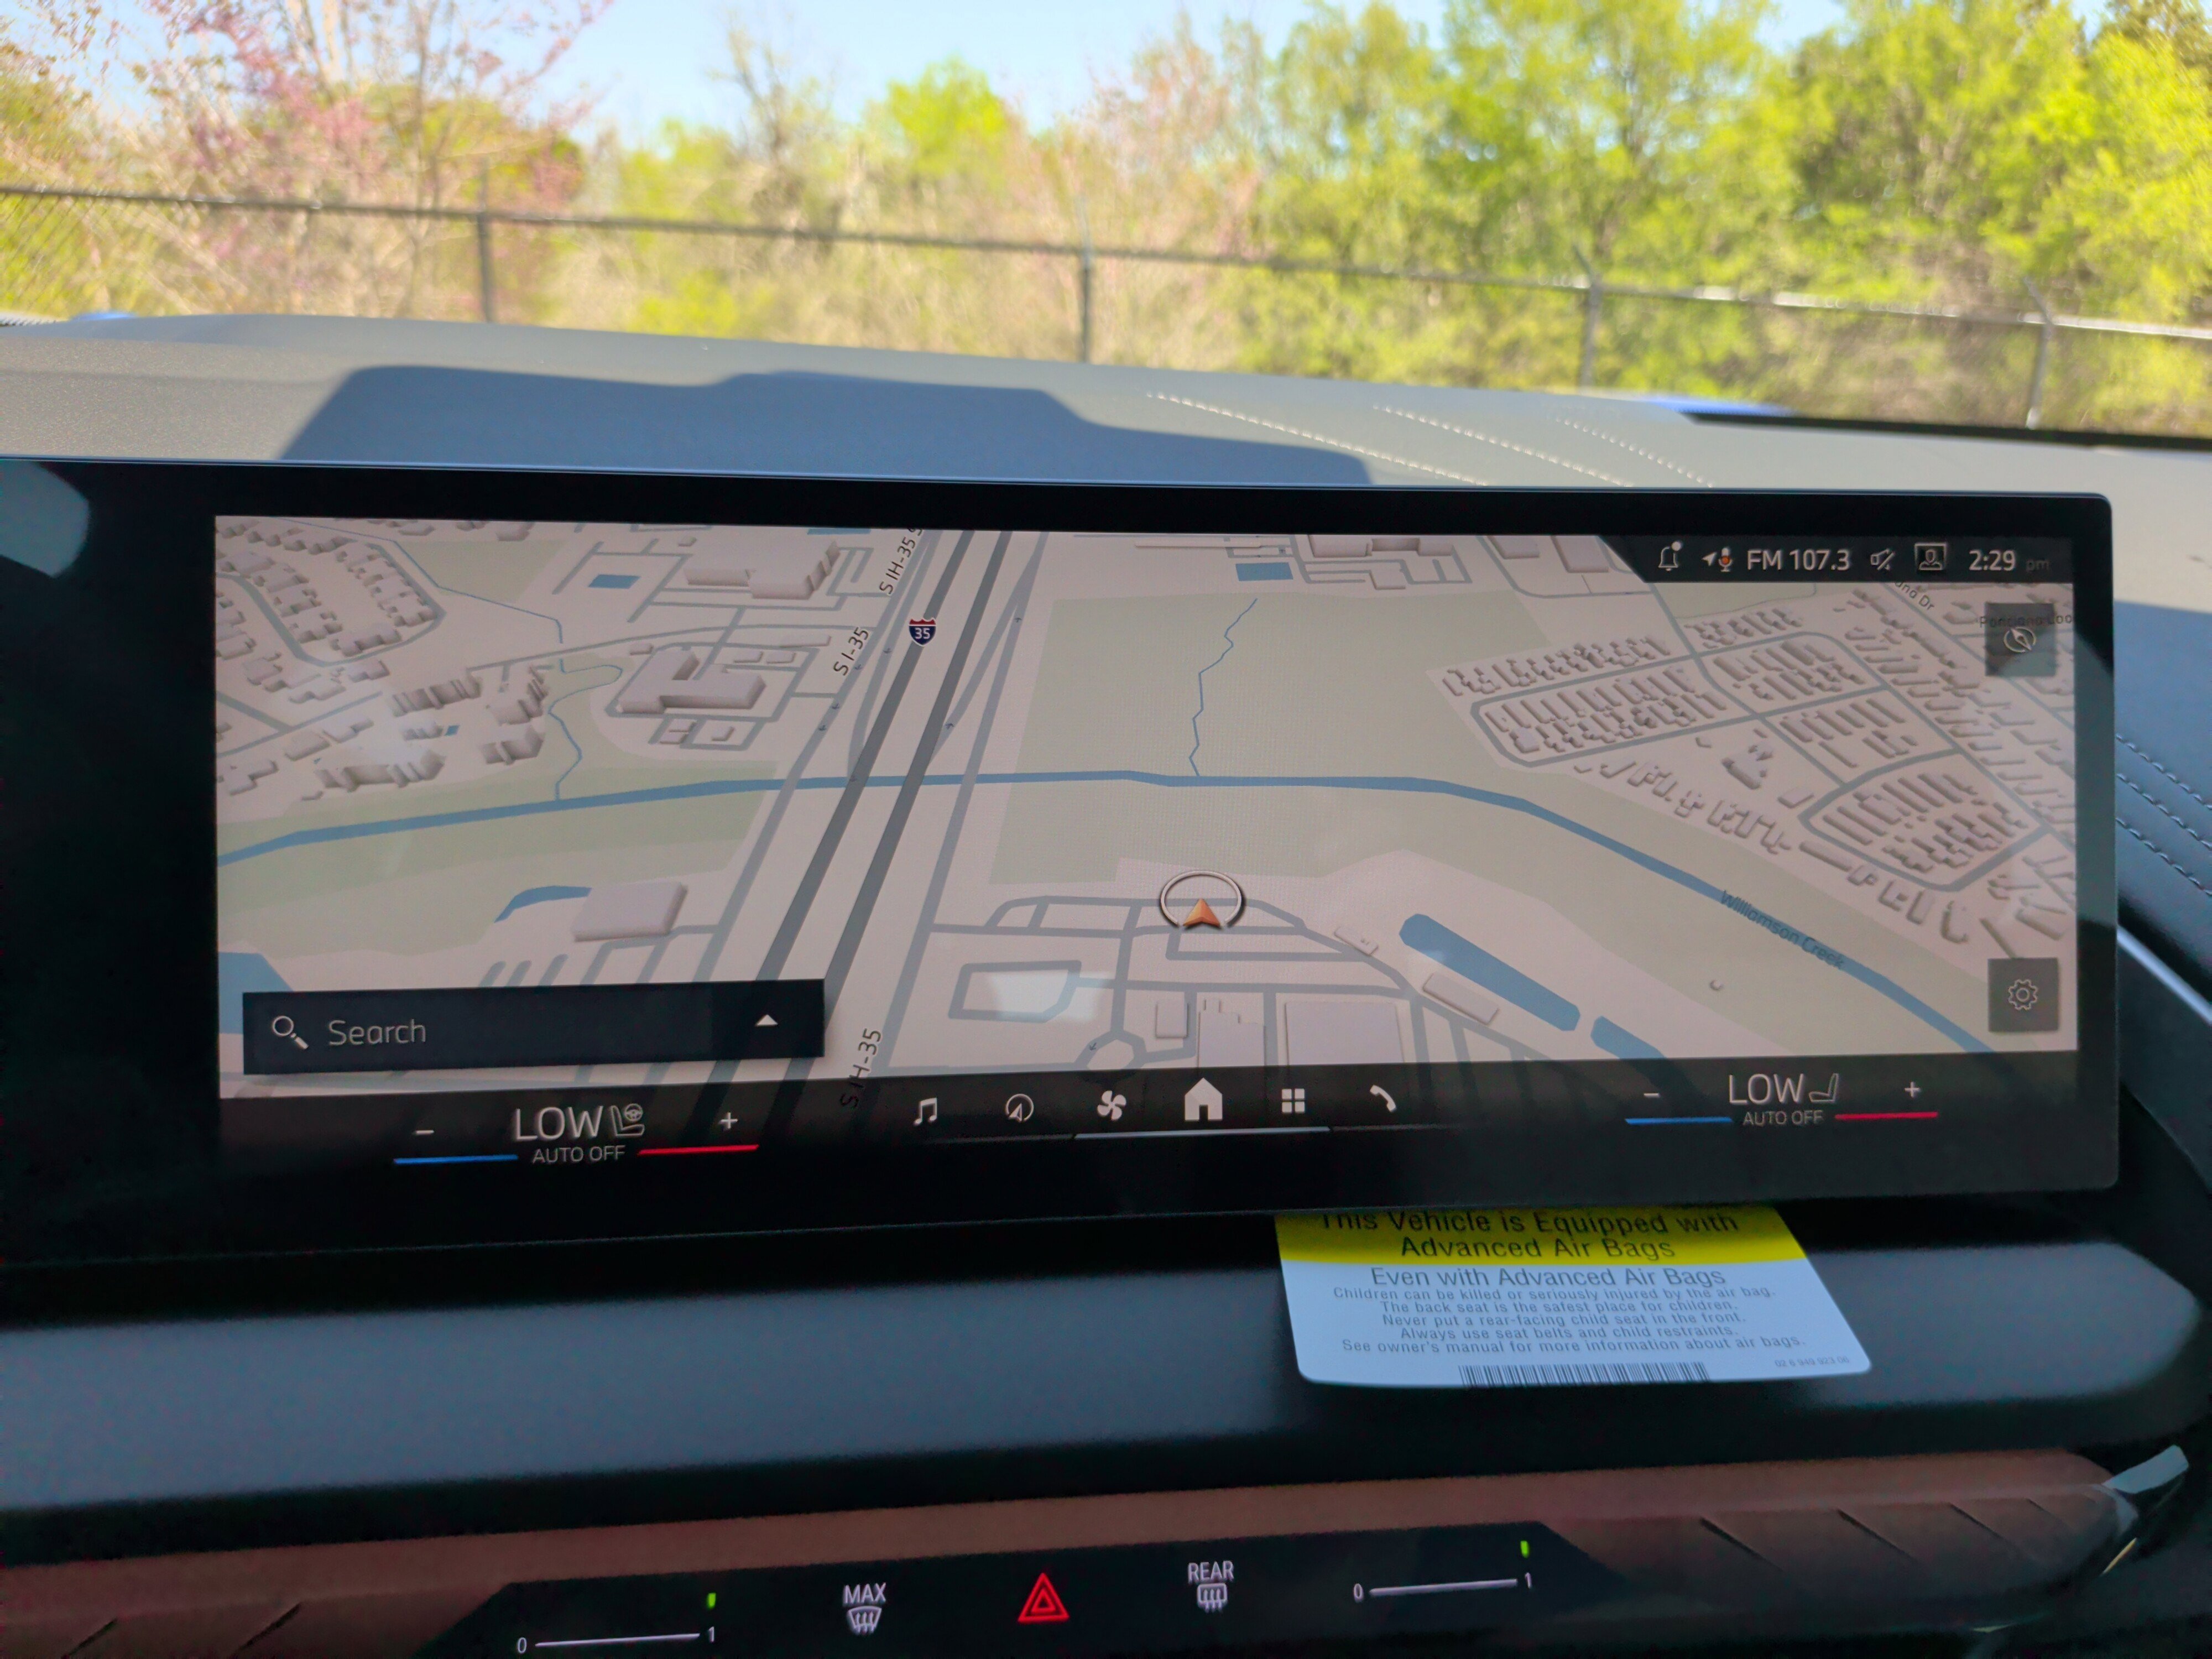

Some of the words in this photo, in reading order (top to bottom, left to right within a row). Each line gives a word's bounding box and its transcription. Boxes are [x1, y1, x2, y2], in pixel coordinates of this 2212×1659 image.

[885, 536, 916, 580] IH-35
[1747, 550, 1782, 570] FM
[1789, 549, 1850, 571] 107.3
[1969, 550, 2016, 571] 2:29
[2026, 560, 2050, 572] pm
[879, 581, 893, 594] S
[1919, 595, 1934, 610] Dr
[915, 628, 930, 640] 35
[833, 661, 849, 676] S
[841, 627, 869, 661] I-35
[1721, 889, 1799, 945] Williamson
[1802, 937, 1844, 970] Creek
[328, 1019, 427, 1046] Search
[1729, 1074, 1804, 1104] LOW
[515, 1106, 603, 1141] LOW
[1743, 1111, 1787, 1126] AUTO
[1791, 1110, 1824, 1125] OFF
[532, 1146, 584, 1164] AUTO
[589, 1145, 626, 1161] OFF
[1387, 1210, 1491, 1232] Vehicle
[1500, 1211, 1525, 1232] is
[1533, 1211, 1669, 1237] Equipped
[1676, 1213, 1739, 1233] with
[1401, 1237, 1542, 1256] Advanced
[1554, 1237, 1590, 1257] Air
[1601, 1238, 1675, 1261] Bags
[1371, 1267, 1430, 1286] Even
[1437, 1268, 1489, 1286] with
[1499, 1268, 1616, 1286] Advanced
[1625, 1267, 1655, 1286] Air
[1663, 1267, 1726, 1288] Bags
[1333, 1287, 1398, 1299] Children
[1404, 1291, 1431, 1300] can
[1436, 1288, 1454, 1300] be
[1460, 1288, 1501, 1300] killed
[1507, 1291, 1522, 1300] or
[1528, 1288, 1598, 1300] seriously
[1605, 1288, 1658, 1300] injured
[1663, 1288, 1681, 1300] by
[1686, 1288, 1711, 1298] the
[1716, 1287, 1736, 1297] air
[1740, 1286, 1776, 1297] bag.
[1380, 1301, 1409, 1312] The
[1415, 1302, 1451, 1312] back
[1457, 1302, 1489, 1312] seat
[1494, 1302, 1507, 1312] is
[1514, 1302, 1537, 1312] the
[1543, 1301, 1590, 1312] safest
[1595, 1301, 1636, 1314] place
[1642, 1301, 1662, 1312] for
[1669, 1300, 1738, 1311] children.
[1383, 1314, 1427, 1326] Never
[1434, 1315, 1459, 1327] put
[1465, 1317, 1473, 1326] a
[1479, 1314, 1565, 1327] rear-facing
[1571, 1313, 1609, 1325] child
[1614, 1313, 1647, 1324] seat
[1651, 1313, 1667, 1324] in
[1671, 1312, 1697, 1324] the
[1701, 1311, 1746, 1323] front.
[1401, 1328, 1455, 1341] Always
[1462, 1329, 1489, 1339] use
[1496, 1328, 1528, 1339] seat
[1533, 1327, 1572, 1339] belts
[1579, 1327, 1607, 1338] and
[1613, 1326, 1651, 1338] child
[1657, 1325, 1739, 1337] restraints.
[1342, 1339, 1371, 1352] See
[1378, 1341, 1439, 1353] owner's
[1446, 1341, 1504, 1352] manual
[1510, 1340, 1532, 1352] for
[1539, 1342, 1580, 1352] more
[1585, 1339, 1679, 1351] information
[1684, 1338, 1730, 1350] about
[1736, 1337, 1756, 1348] air
[1760, 1336, 1806, 1348] bags.
[1188, 1561, 1234, 1583] REAR
[843, 1582, 886, 1605] MAX
[1353, 1583, 1363, 1602] 0
[1525, 1572, 1531, 1589] 1
[517, 1637, 527, 1654] 0
[707, 1627, 716, 1643] 1
